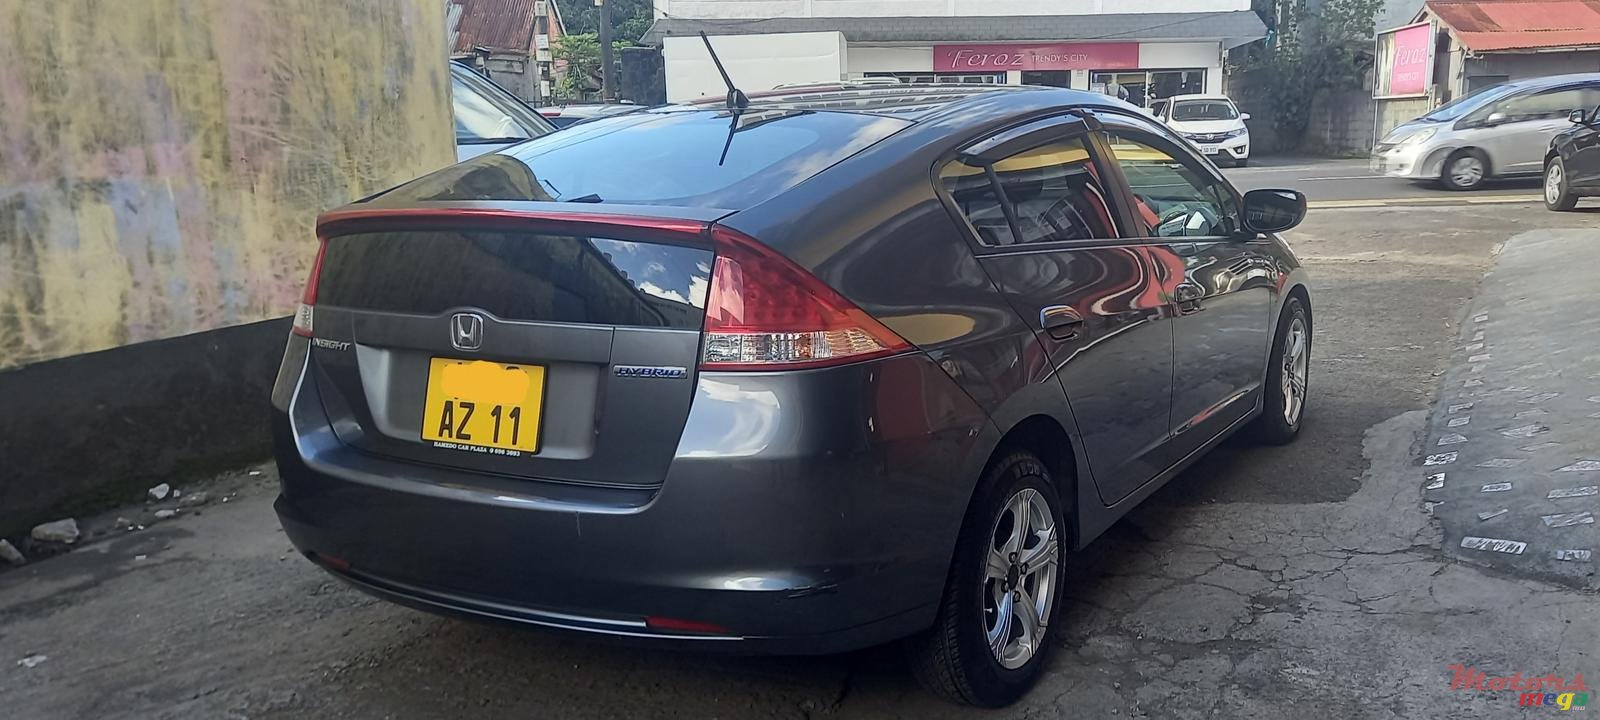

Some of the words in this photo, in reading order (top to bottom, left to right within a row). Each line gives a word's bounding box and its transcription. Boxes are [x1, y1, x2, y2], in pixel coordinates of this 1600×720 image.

[947, 49, 1025, 68] Feroz
[1031, 54, 1069, 63] TRENDY'S
[1070, 54, 1088, 62] CITY
[311, 337, 351, 350] INSIGHT
[616, 366, 683, 378] HYBRID
[438, 400, 475, 440] AZ
[491, 404, 521, 445] 11
